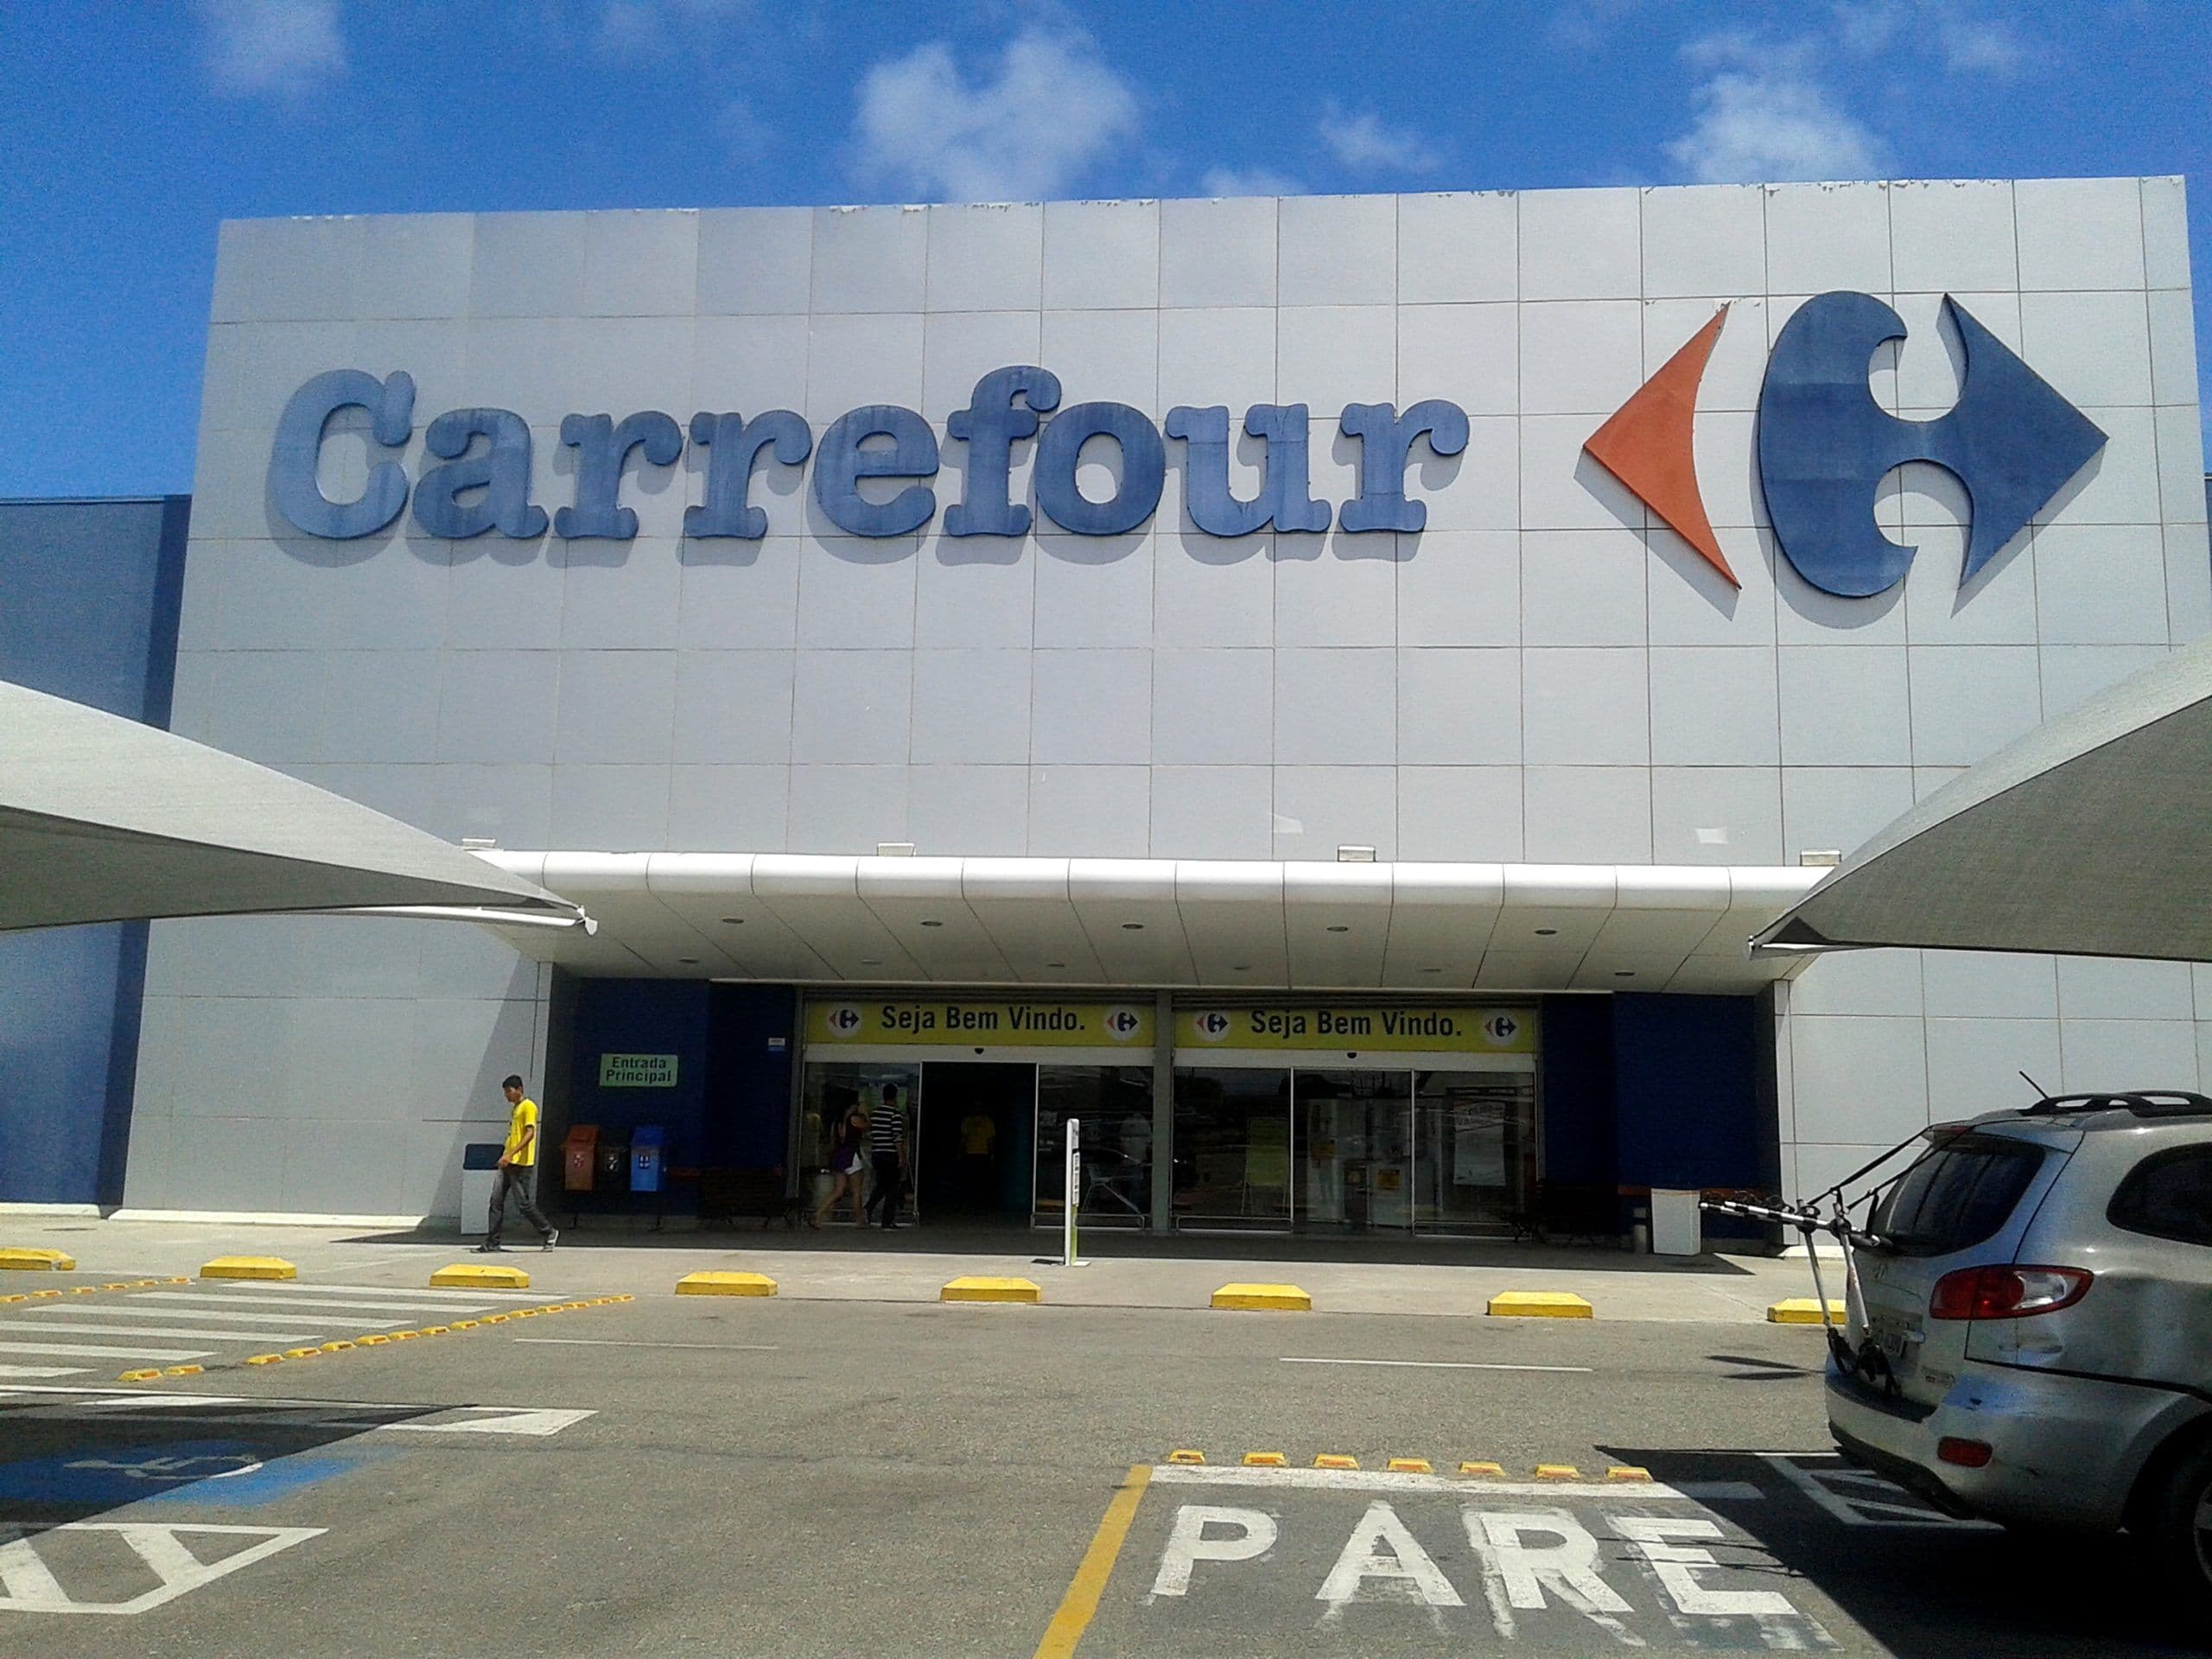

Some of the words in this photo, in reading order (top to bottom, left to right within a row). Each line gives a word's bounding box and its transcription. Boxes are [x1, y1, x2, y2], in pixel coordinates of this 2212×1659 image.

[270, 365, 1471, 539] Carrefour
[881, 1006, 935, 1034] Seja
[947, 1007, 998, 1030] Bem
[1008, 1007, 1085, 1031] Vindo.
[1250, 1010, 1306, 1039] Seja
[1318, 1010, 1371, 1035] Bem
[1382, 1012, 1462, 1037] Vindo.
[607, 1069, 671, 1084] Principal
[612, 1056, 667, 1069] Entrada
[1152, 1499, 1799, 1614] PARE
